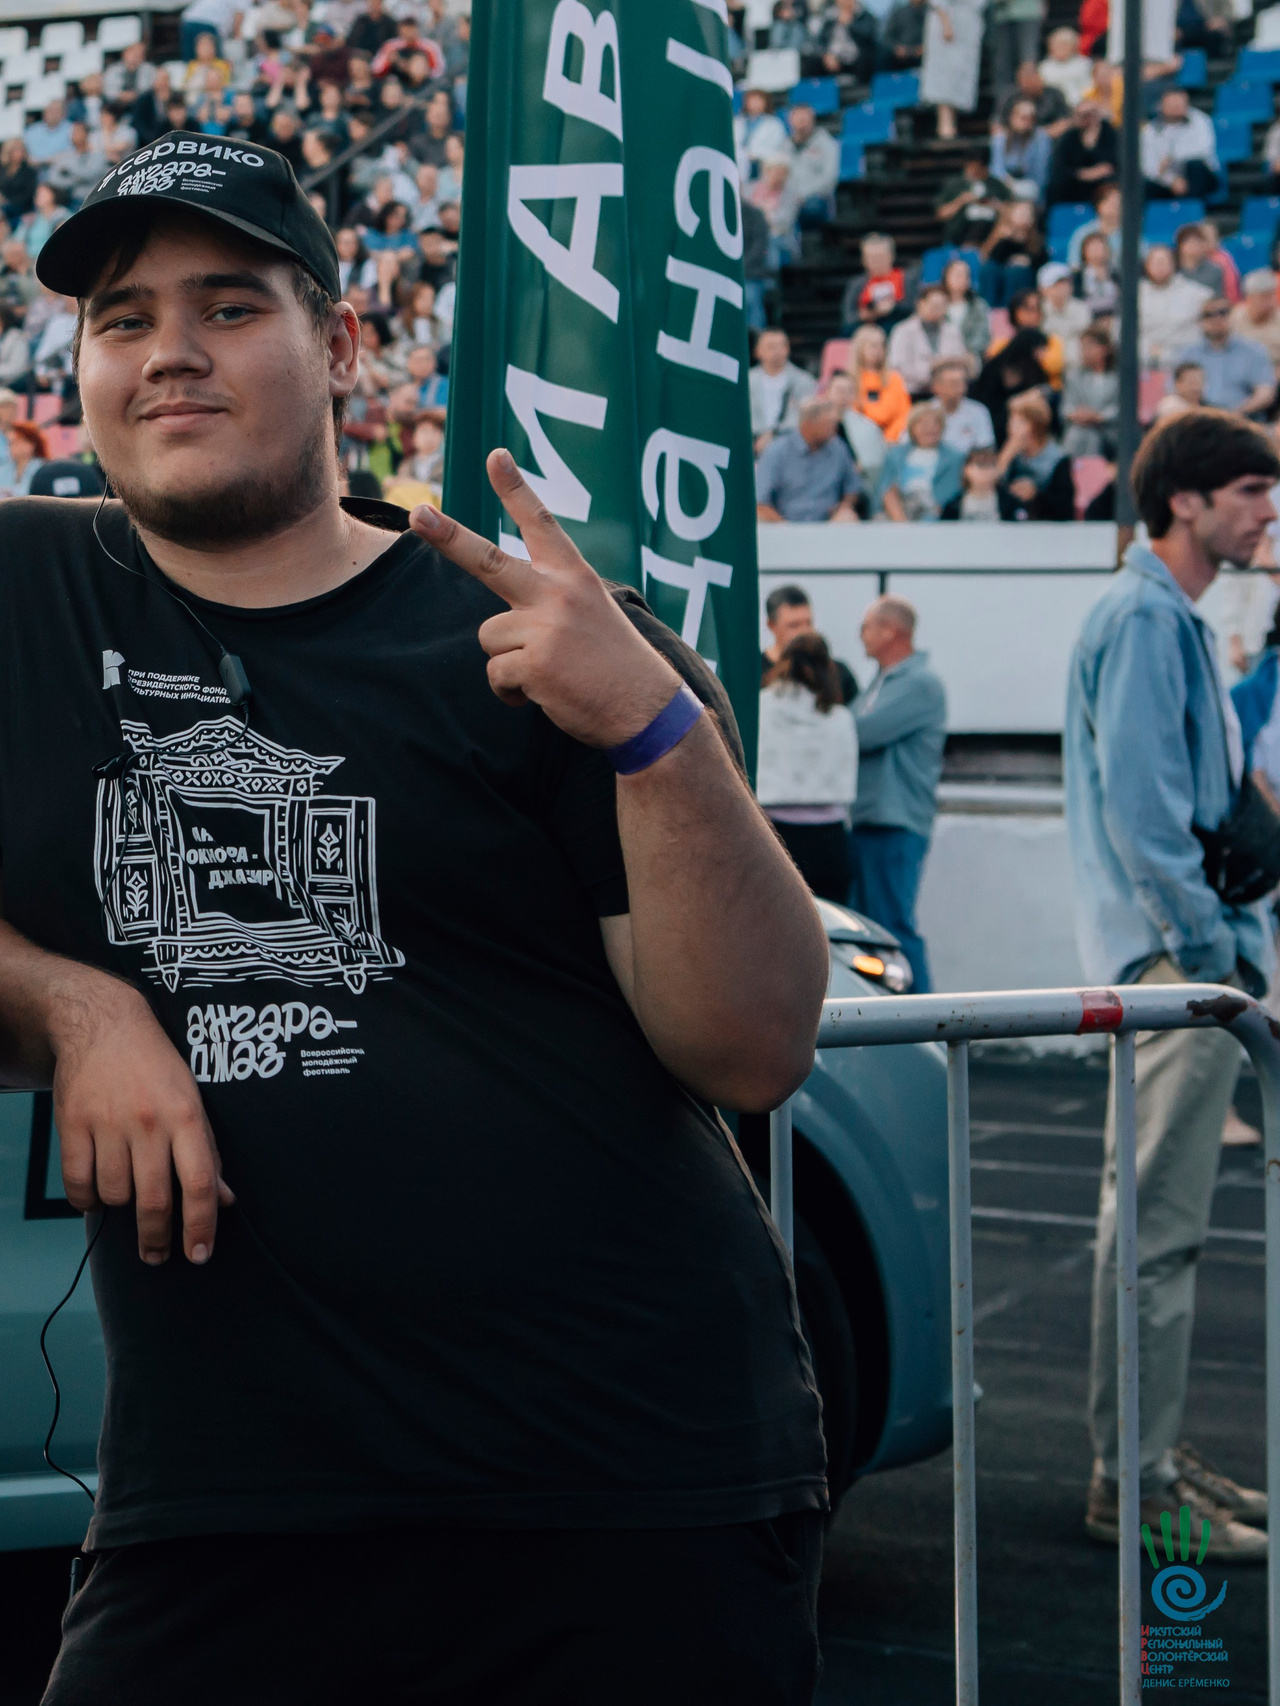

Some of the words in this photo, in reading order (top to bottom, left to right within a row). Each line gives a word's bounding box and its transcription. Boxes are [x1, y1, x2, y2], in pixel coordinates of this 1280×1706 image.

[147, 672, 201, 683] ПОДДЕРЖКЕ
[180, 692, 232, 704] ИНИЦИАТИВ
[301, 1056, 358, 1067] молодёжный
[302, 1067, 351, 1078] фестиваль
